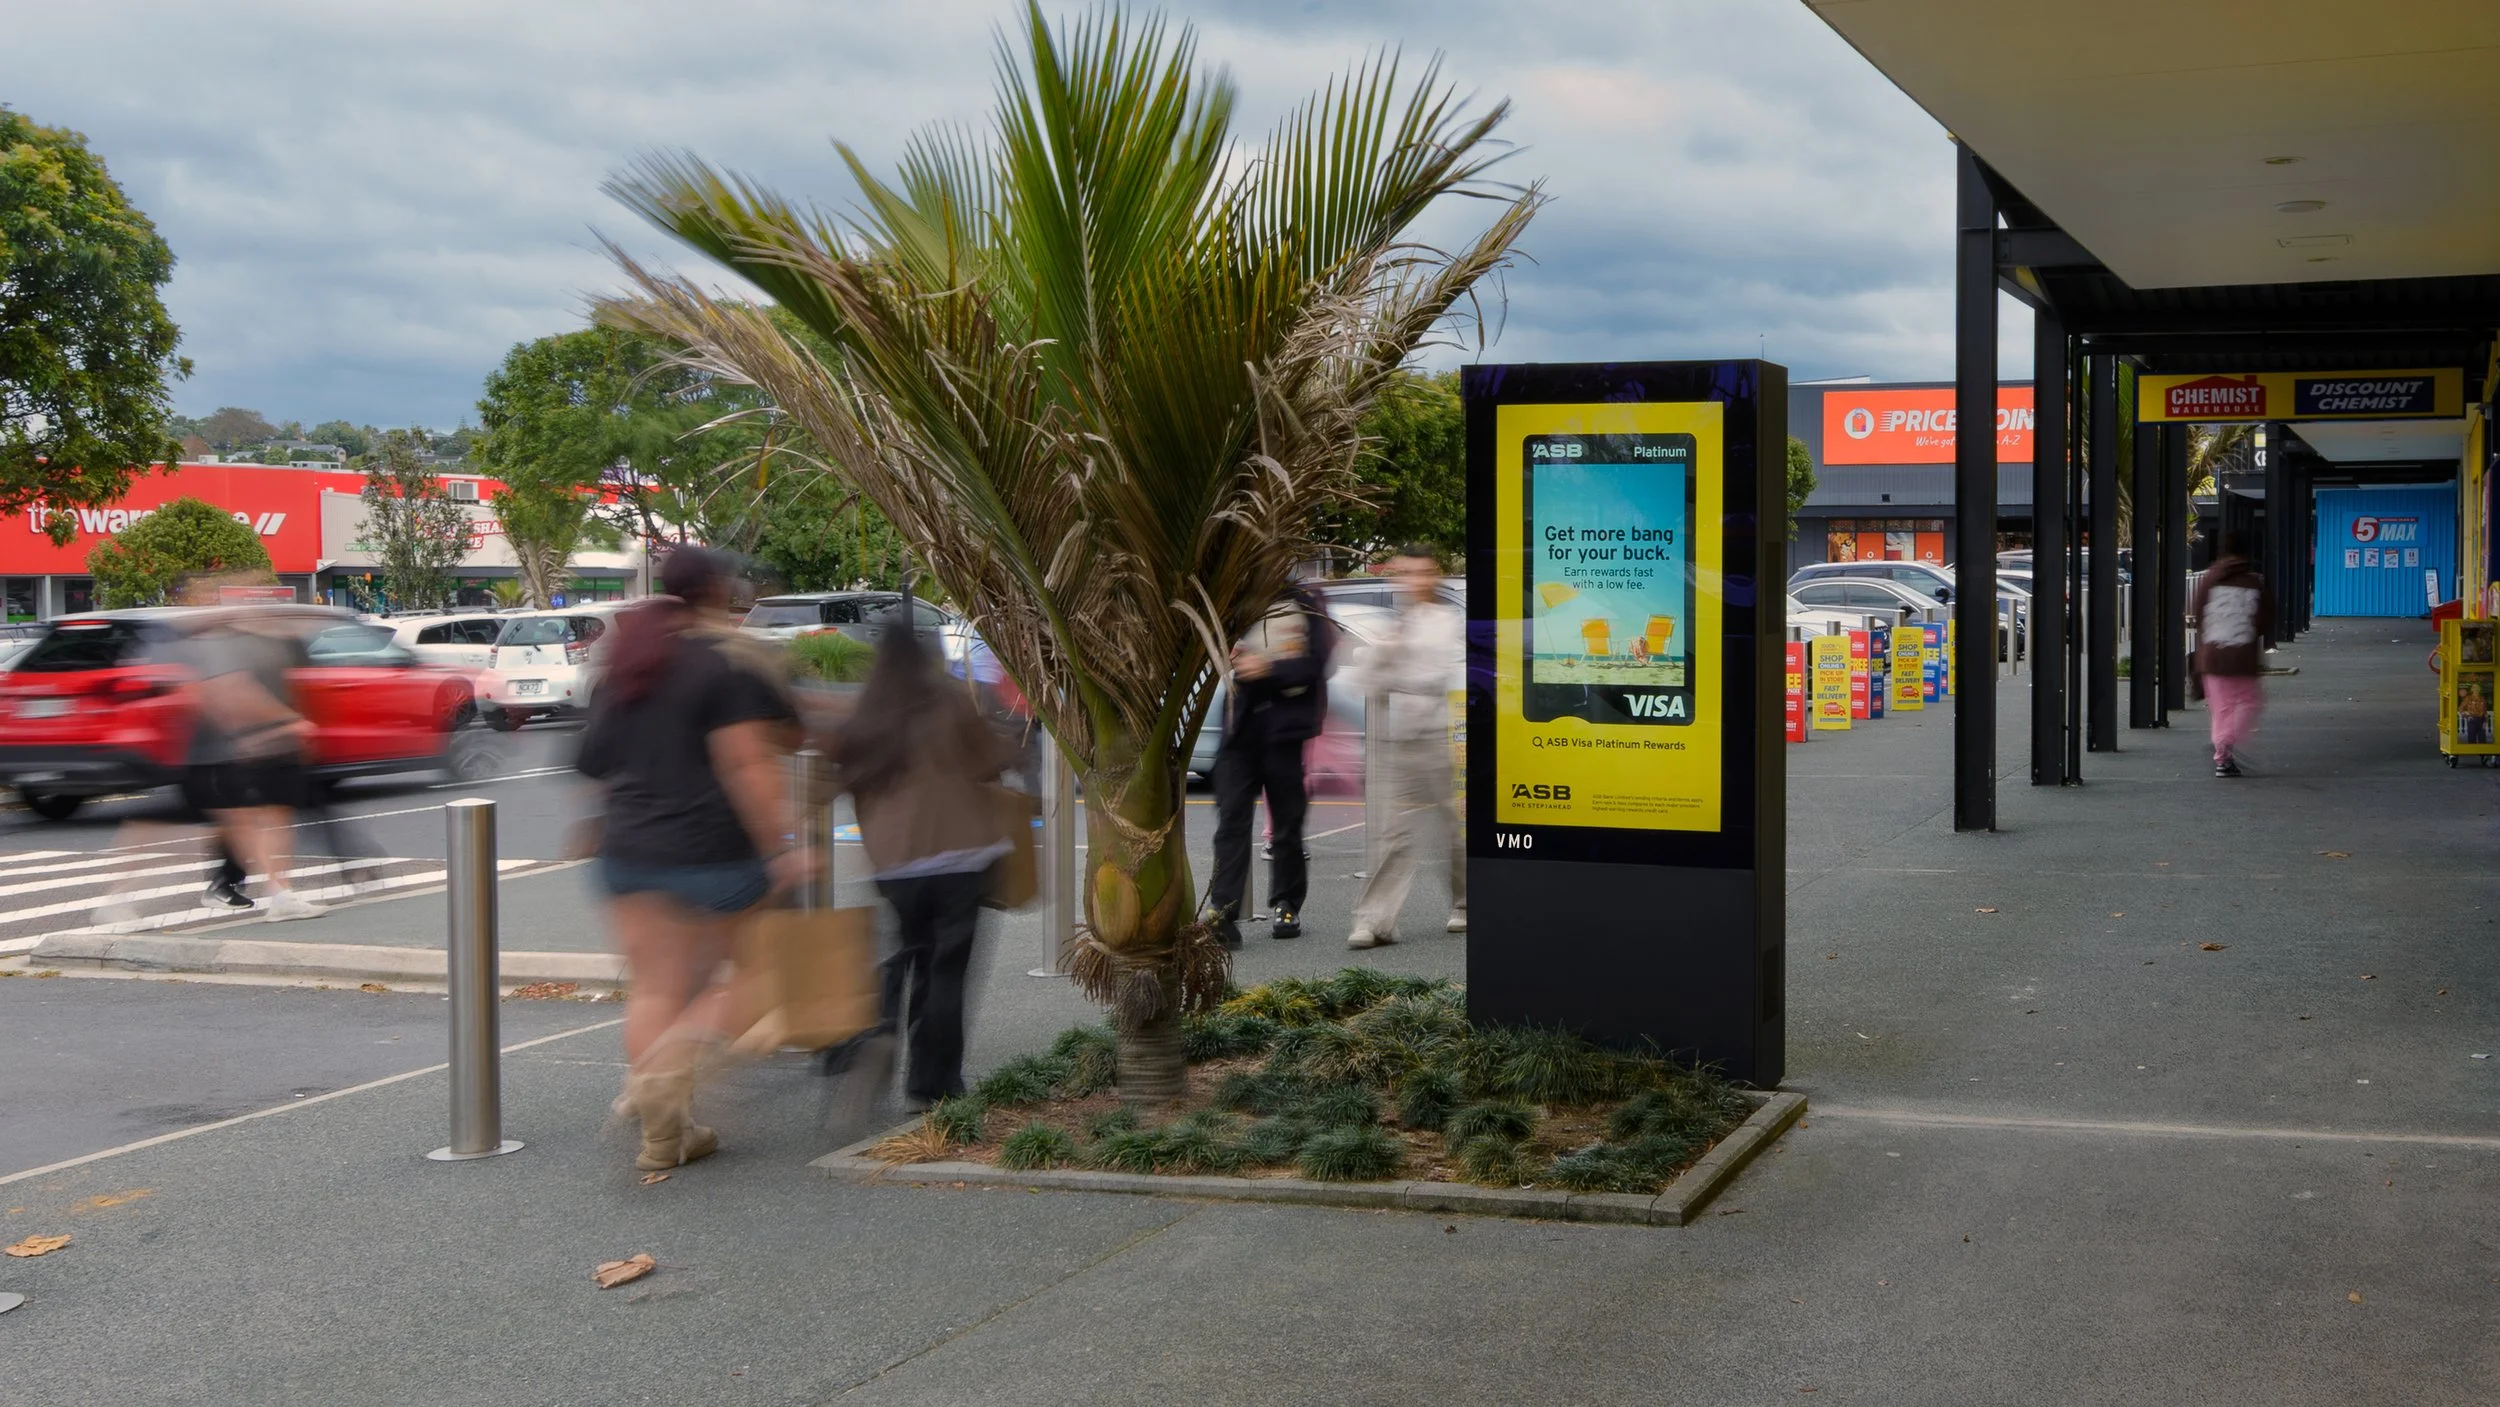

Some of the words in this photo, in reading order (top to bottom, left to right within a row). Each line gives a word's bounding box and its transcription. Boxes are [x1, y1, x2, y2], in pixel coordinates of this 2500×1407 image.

[2171, 387, 2260, 405] CHEMIST
[2310, 381, 2423, 396] DISCOUNT
[2171, 404, 2260, 414] WAREHOUSE
[2318, 396, 2412, 410] CHEMIST
[1889, 409, 1956, 432] PRICE
[1997, 408, 2034, 431] OIN
[1532, 444, 1583, 458] ASB
[1634, 446, 1687, 458] Platinum
[1545, 526, 1575, 541] Get
[1581, 529, 1626, 541] more
[1632, 525, 1673, 545] bang
[2356, 516, 2378, 542] 5
[1548, 545, 1572, 560] for
[1578, 548, 1617, 564] your
[1623, 544, 1670, 560] buck.
[1564, 567, 1588, 577] Earn
[1590, 566, 1631, 577] rewards
[1634, 566, 1654, 577] fast
[1572, 579, 1595, 590] with
[1597, 582, 1604, 590] a
[1606, 579, 1623, 590] low
[1626, 580, 1645, 590] fee.
[1623, 694, 1686, 718] VISA
[1547, 737, 1568, 747] ASB
[1571, 738, 1593, 748] Visa
[1596, 739, 1640, 749] Platinum
[1644, 740, 1686, 751] Rewards
[1512, 783, 1571, 801] ASB
[1496, 833, 1533, 850] VMO
